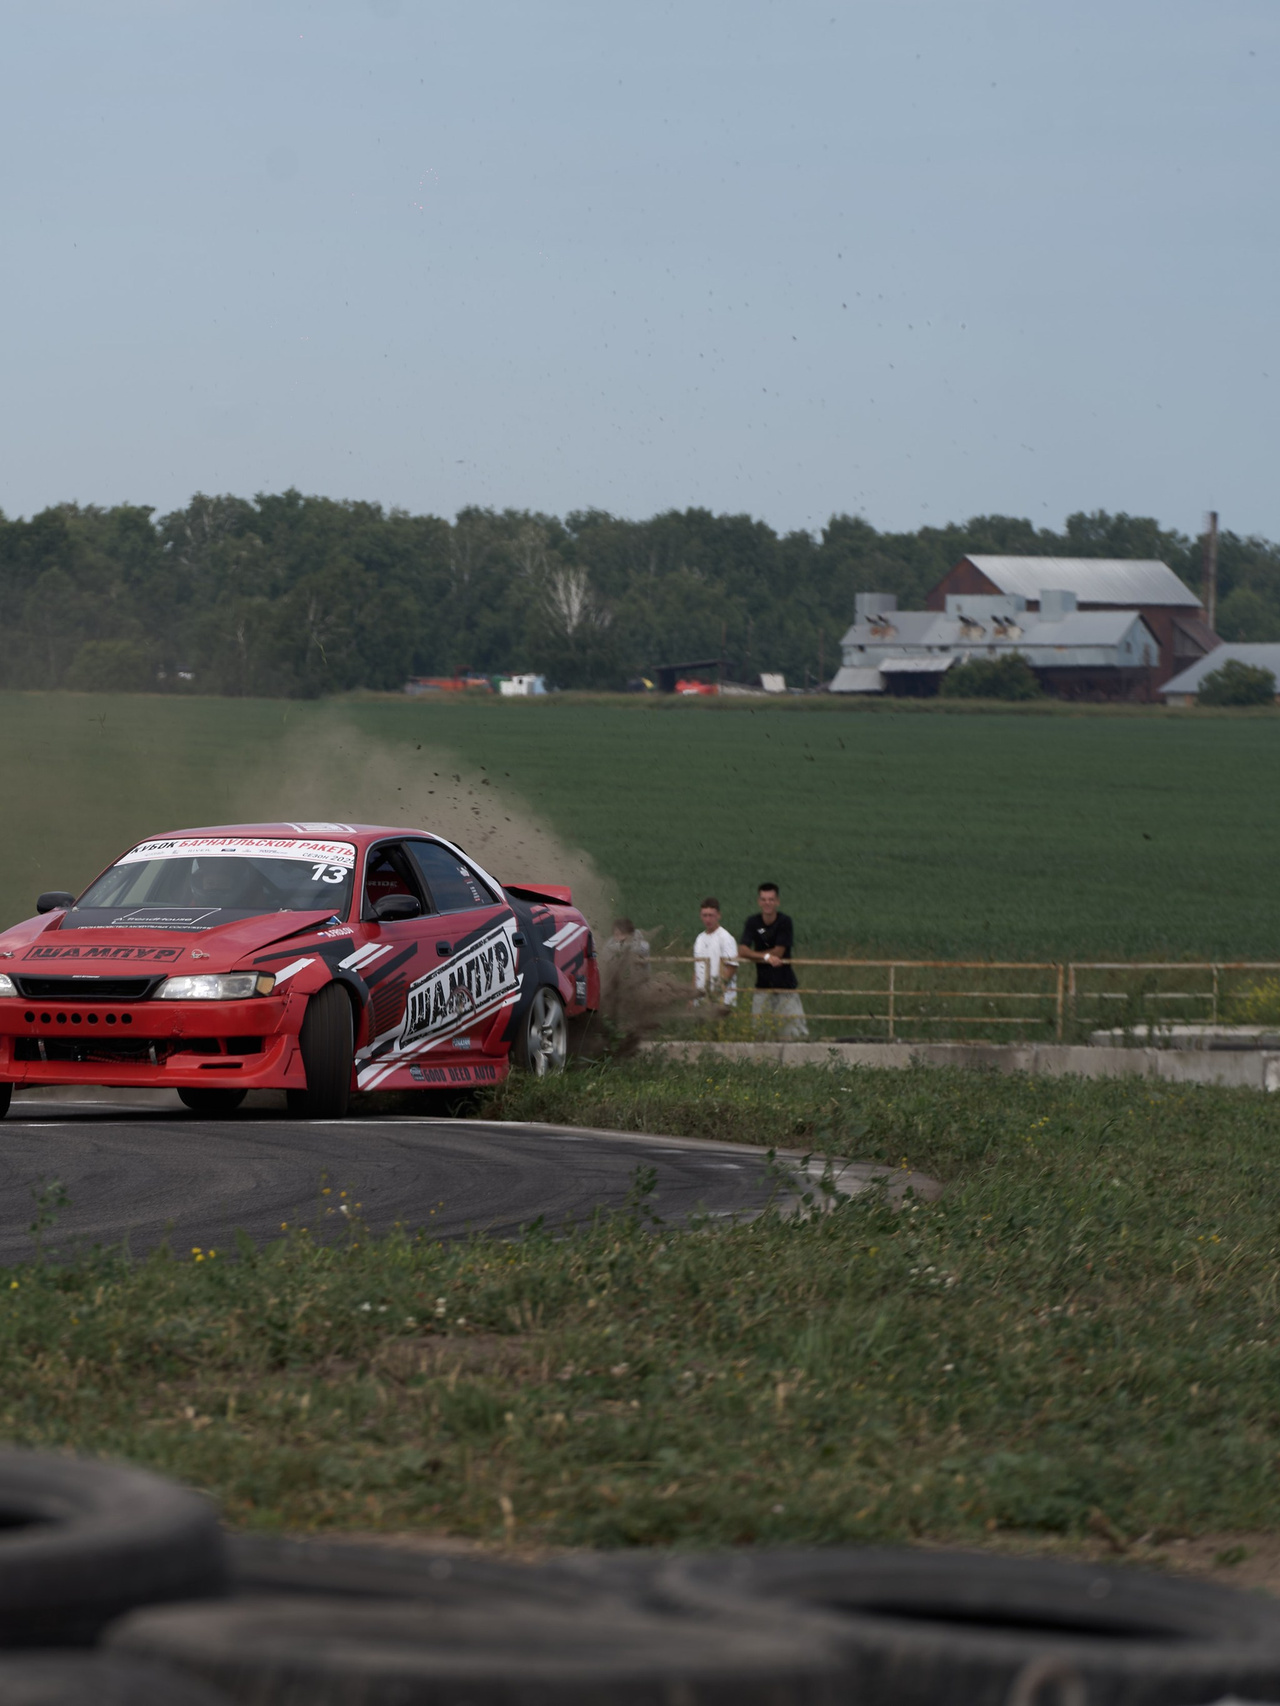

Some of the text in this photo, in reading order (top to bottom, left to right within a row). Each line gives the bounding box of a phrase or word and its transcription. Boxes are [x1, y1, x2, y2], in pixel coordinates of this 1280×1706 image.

[130, 841, 179, 854] КУБОК
[178, 838, 298, 849] БАРНАУЛЬСКОЙ
[311, 863, 348, 884] 13
[32, 946, 177, 960] ШАМПУР
[410, 941, 510, 1036] ШАМПУР
[423, 1067, 447, 1083] GOOD
[448, 1066, 471, 1082] DEED
[473, 1064, 496, 1080] AUTO
